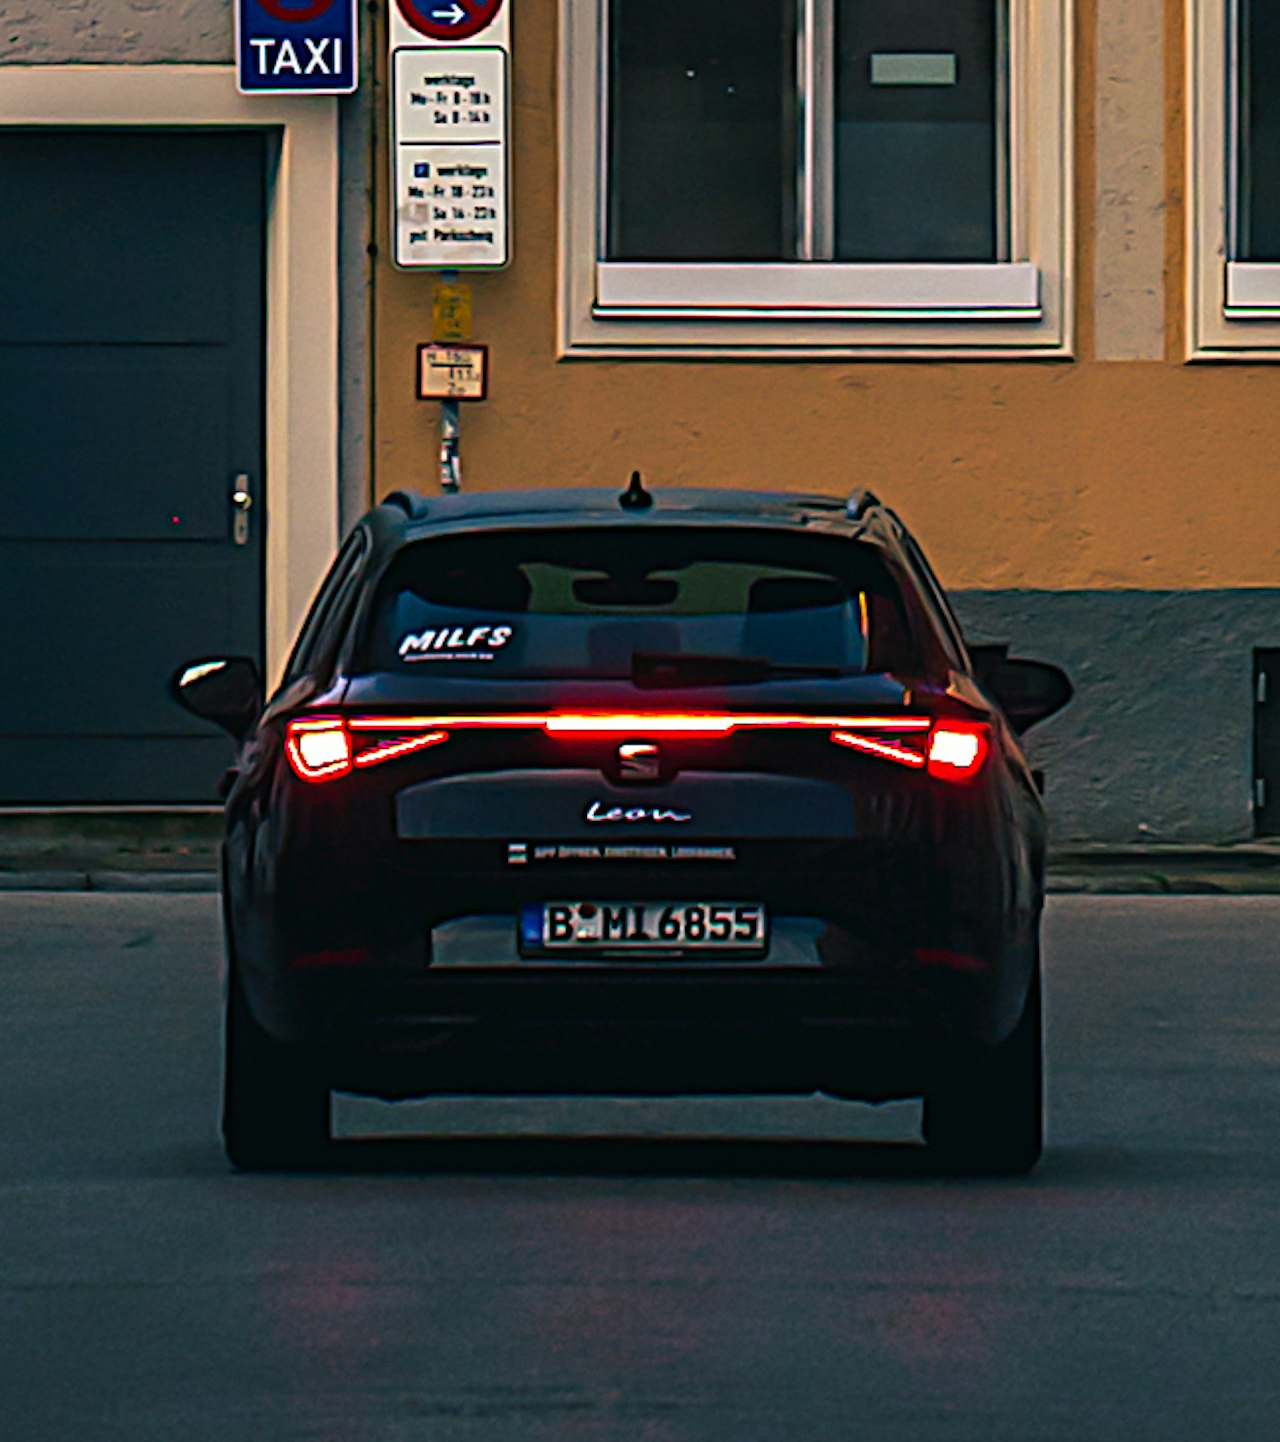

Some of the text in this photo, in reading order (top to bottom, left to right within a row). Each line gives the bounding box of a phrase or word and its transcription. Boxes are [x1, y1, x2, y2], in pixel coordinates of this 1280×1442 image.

[249, 38, 342, 74] TAXI
[398, 625, 513, 656] MILFS
[585, 800, 692, 822] Leon
[549, 906, 575, 942] B
[658, 906, 759, 942] 6855
